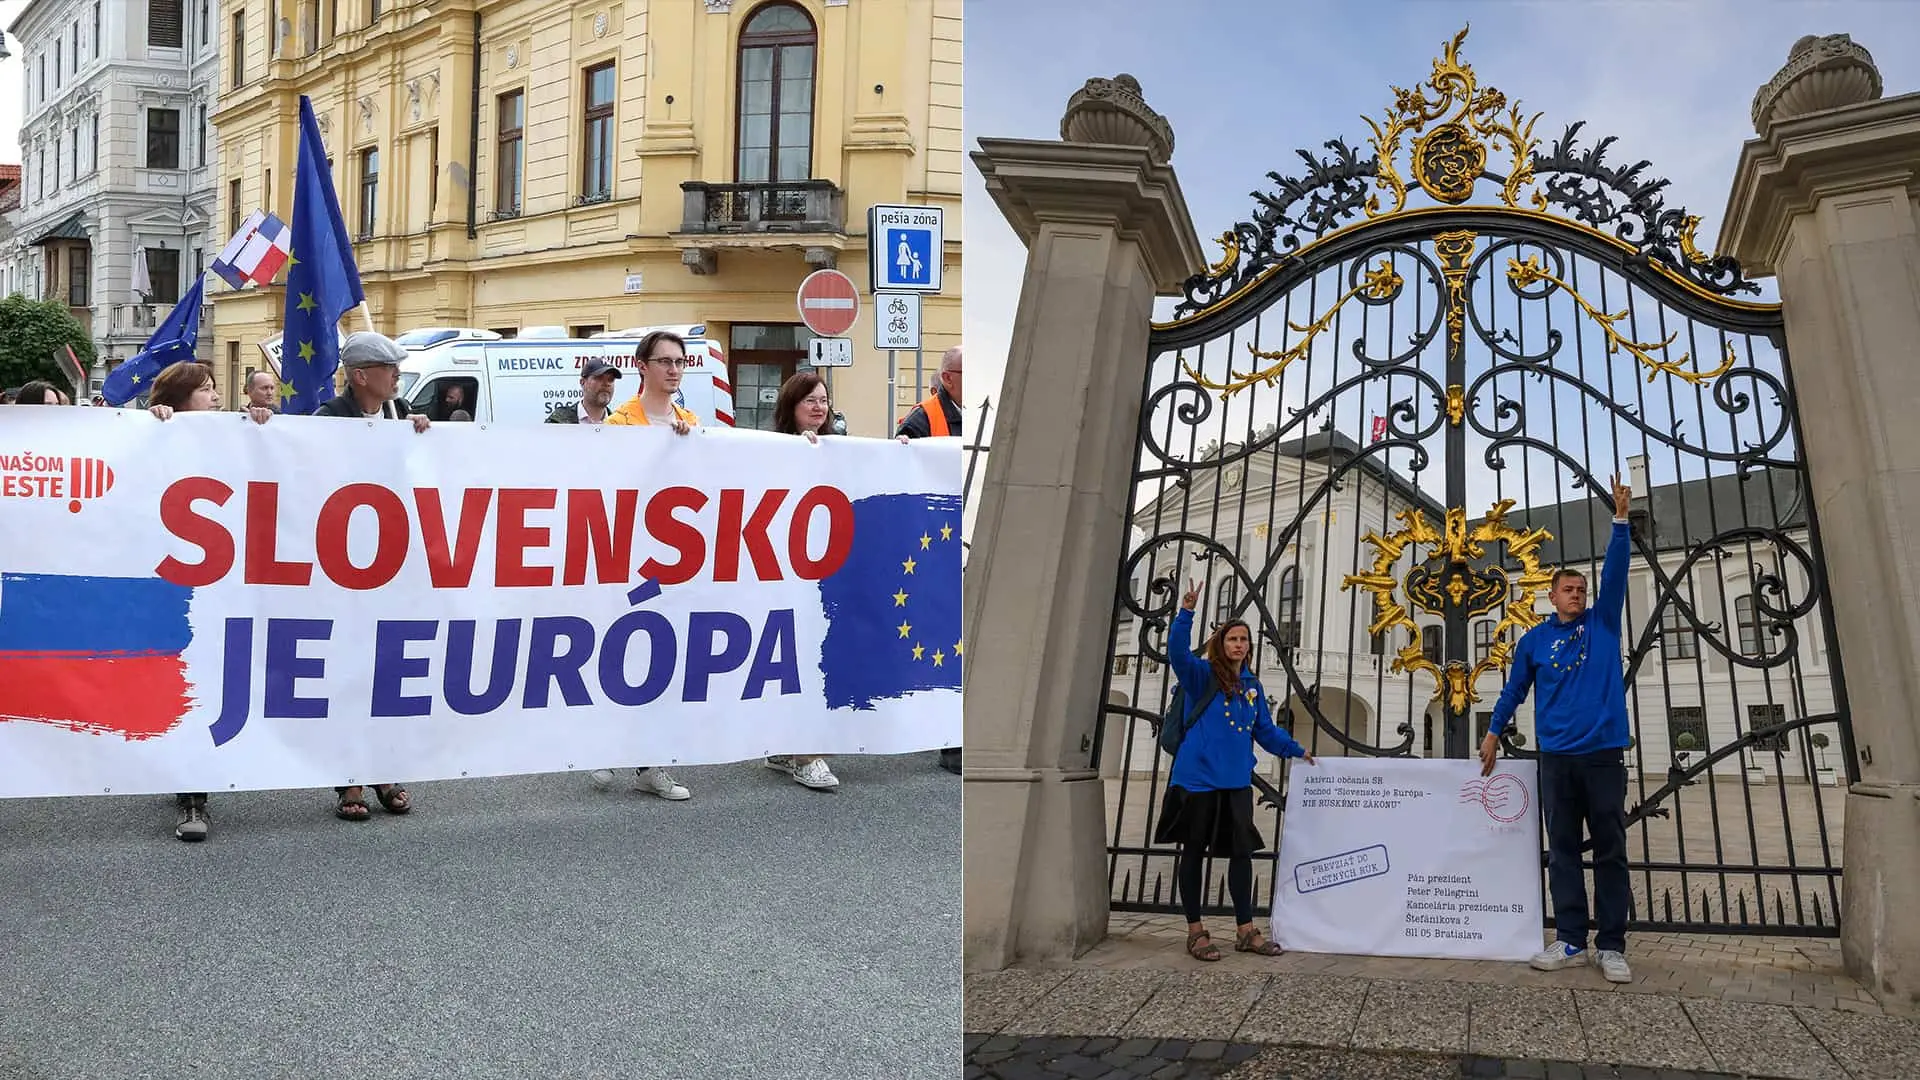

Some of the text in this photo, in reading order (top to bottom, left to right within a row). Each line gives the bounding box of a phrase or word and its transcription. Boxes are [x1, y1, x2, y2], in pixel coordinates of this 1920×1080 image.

[881, 211, 937, 225] pešia zóna
[498, 357, 564, 370] MEDEVAC
[543, 390, 566, 399] 0949
[0, 451, 64, 473] NAŠOM
[3, 476, 64, 498] ESTE
[155, 476, 855, 589] SLOVENSKO
[208, 577, 802, 747] JE EURÓPA
[1337, 776, 1370, 785] občania
[1372, 777, 1383, 785] SR
[1303, 787, 1331, 796] Pochod
[1382, 788, 1391, 798] je
[1393, 788, 1424, 798] Európa
[1302, 799, 1316, 808] NIE
[1318, 799, 1360, 808] RUSKÉMU
[1356, 854, 1368, 864] DO
[1407, 873, 1471, 885] Pán prezident
[1407, 887, 1479, 898] Peter Pellegrini
[1406, 900, 1524, 913] Kancelária prezidenta SR
[1405, 913, 1470, 925] Štefánikova 2
[1405, 928, 1483, 940] 811 05 Bratislava
